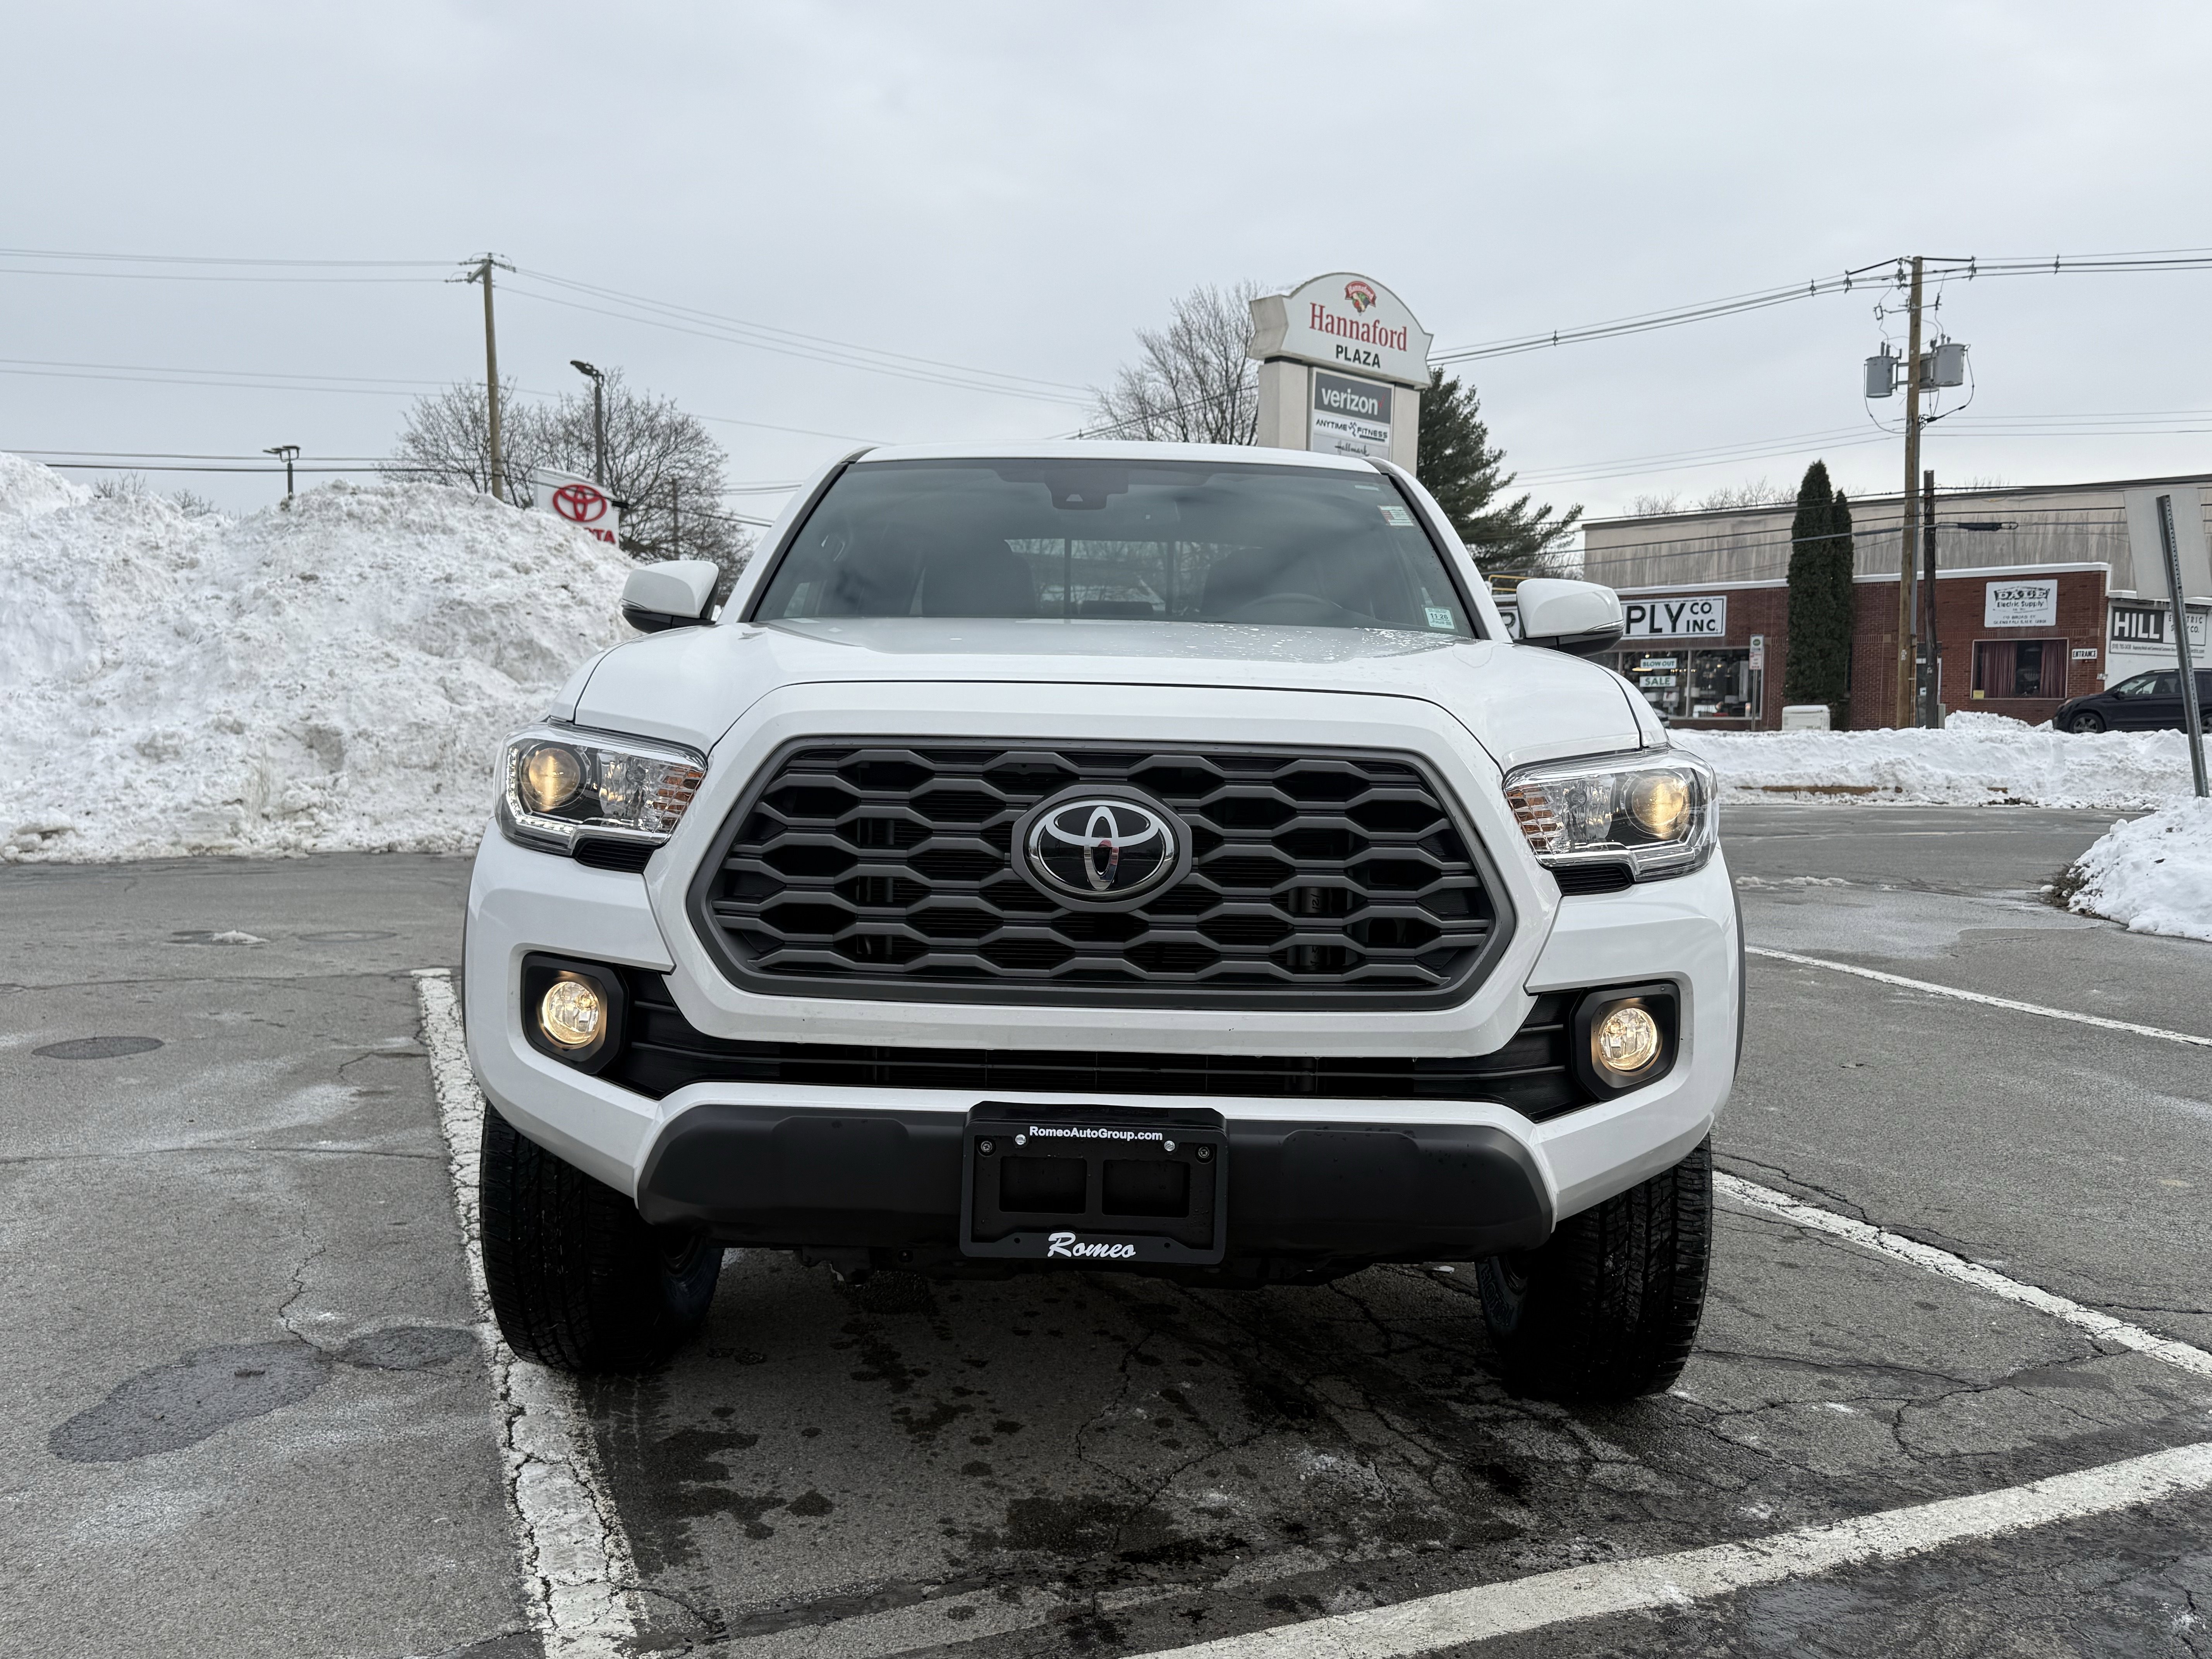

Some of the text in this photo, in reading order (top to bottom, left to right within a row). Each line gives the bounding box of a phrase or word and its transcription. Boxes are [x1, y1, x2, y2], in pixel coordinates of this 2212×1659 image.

[1309, 302, 1407, 352] Hannaford
[1336, 344, 1381, 368] PLAZA
[1321, 388, 1378, 416] verizon
[1316, 419, 1388, 439] ANYTIME FITNESS
[1334, 440, 1370, 457] Hallmark
[1626, 602, 1713, 634] PLY CO.
[1686, 619, 1718, 632] INC.
[2114, 612, 2160, 639] HILL
[2169, 615, 2202, 623] ETRIC
[1645, 677, 1670, 685] SALE
[1029, 1126, 1163, 1141] RomeoAutoGroup.com
[1047, 1232, 1136, 1258] Romeo
